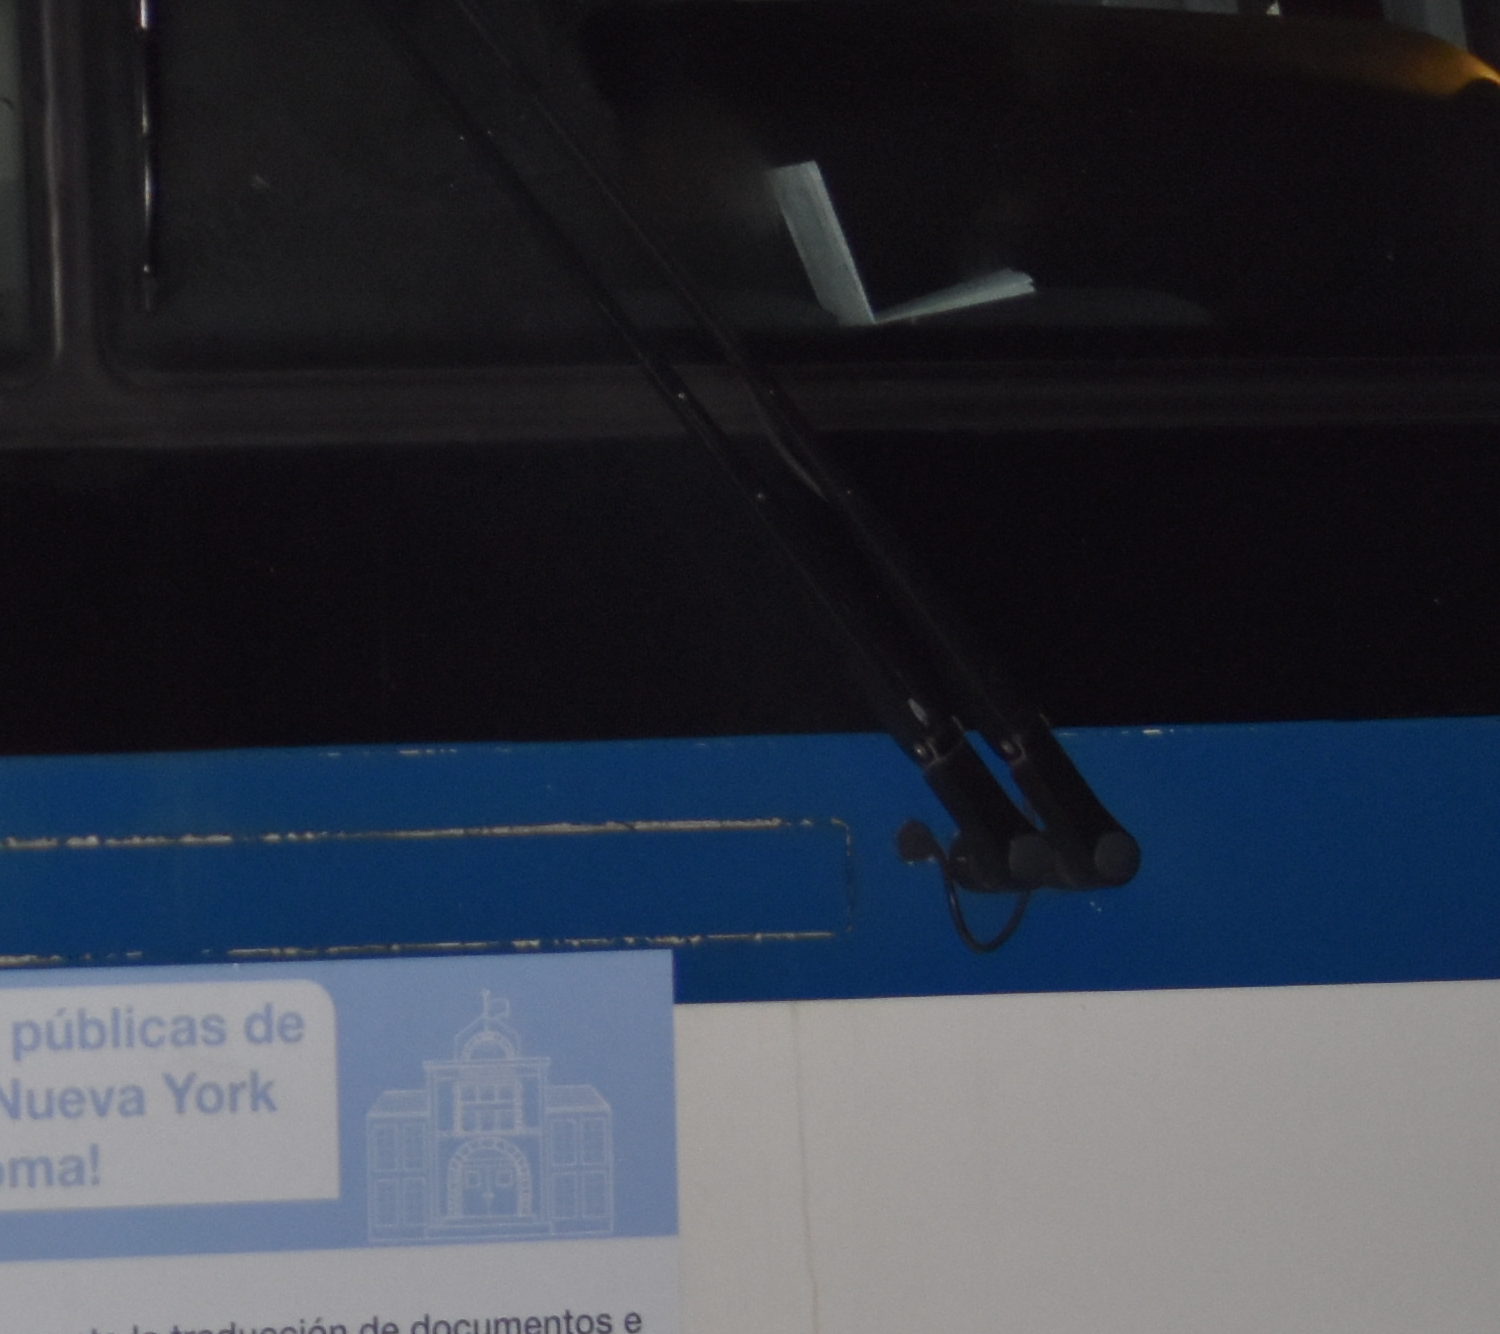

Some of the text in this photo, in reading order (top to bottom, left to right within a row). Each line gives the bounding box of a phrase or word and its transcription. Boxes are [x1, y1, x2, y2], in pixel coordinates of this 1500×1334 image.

[12, 1006, 227, 1061] públicas
[244, 1003, 305, 1045] de
[163, 1071, 278, 1116] York
[624, 1312, 642, 1334] e
